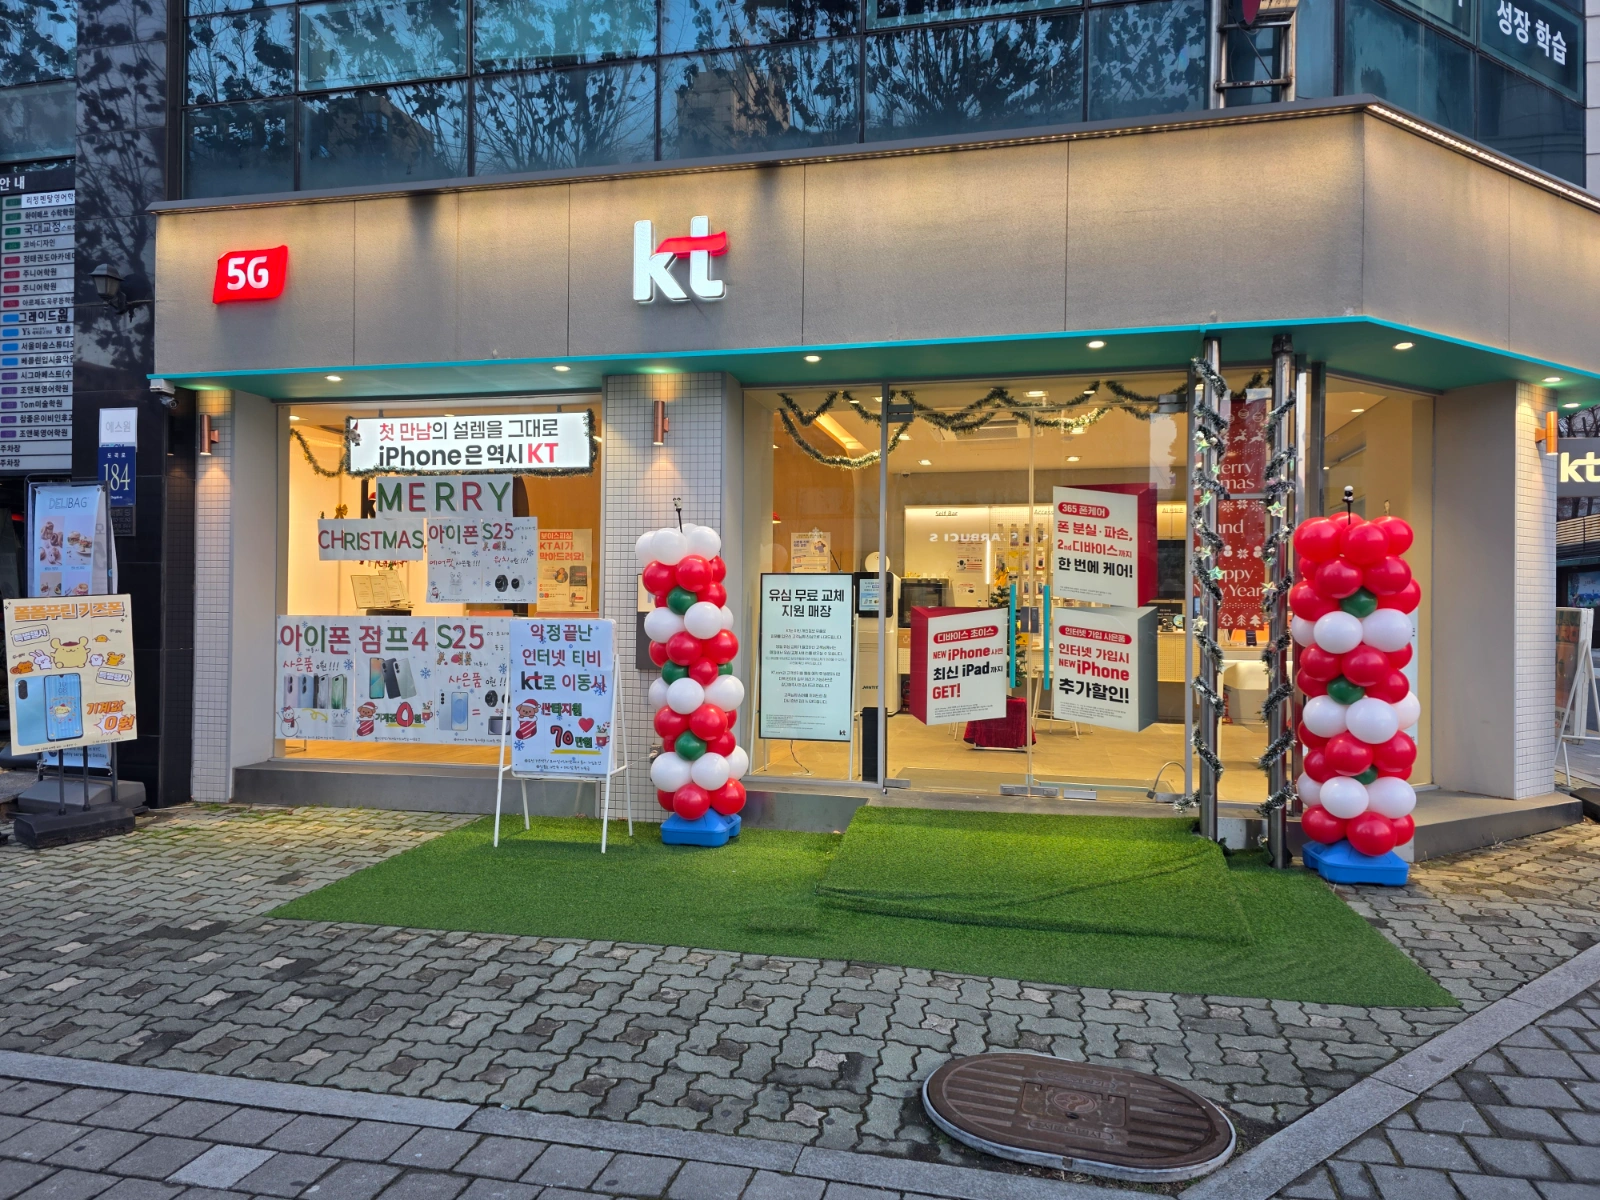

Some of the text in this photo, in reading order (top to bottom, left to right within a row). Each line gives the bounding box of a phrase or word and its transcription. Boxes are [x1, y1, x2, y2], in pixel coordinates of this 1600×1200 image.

[1497, 2, 1567, 65] 성장 학습
[632, 215, 728, 303] kt
[23, 268, 57, 278] 주니어학원
[226, 256, 270, 291] 5G
[22, 282, 57, 292] 주니어학원
[19, 307, 68, 322] 그레이드원
[20, 384, 69, 394] 조앤북영어학원
[20, 399, 63, 409] Tom미술학원
[19, 429, 68, 438] 조앤북영어학원
[105, 420, 131, 433] 에스원
[379, 418, 558, 441] 첫 만남의 설렘을 그대로
[487, 444, 523, 464] 역시
[527, 443, 559, 463] KT
[1560, 451, 1600, 483] kt
[103, 463, 130, 491] 184
[49, 497, 88, 509] DELIBAG
[378, 482, 511, 512] MERRY
[1062, 504, 1106, 517] 365 폰케어
[429, 522, 514, 545] 아이폰 S25
[541, 532, 573, 540] 보이스피싱
[1057, 520, 1070, 533] 폰
[1073, 522, 1097, 537] 분실
[1104, 525, 1133, 541] 파손,
[318, 529, 424, 550] CHRISTMAS
[540, 552, 585, 561] 막아드려요!
[1058, 557, 1133, 578] 한 번에 케어!
[769, 589, 845, 602] 유심 무료 교체
[1228, 583, 1264, 597] Year
[14, 601, 125, 622] 폼폼푸린 키즈폰
[782, 605, 832, 617] 지원 매장
[280, 624, 352, 655] 아이폰
[437, 624, 485, 650] S25
[937, 627, 995, 643] 디바이스 초이스
[1065, 627, 1126, 643] 인터넷 가입 사은품
[572, 650, 601, 667] 티비
[933, 650, 947, 659] NEW
[1058, 643, 1129, 664] 인터넷 가입시
[283, 656, 314, 673] 사은품
[933, 665, 959, 681] 최신
[1059, 658, 1130, 681] NEW iPhone
[448, 672, 483, 689] 사은품
[521, 671, 557, 690] kt로
[932, 683, 961, 700] GET!
[1058, 678, 1130, 704] 추가할인!
